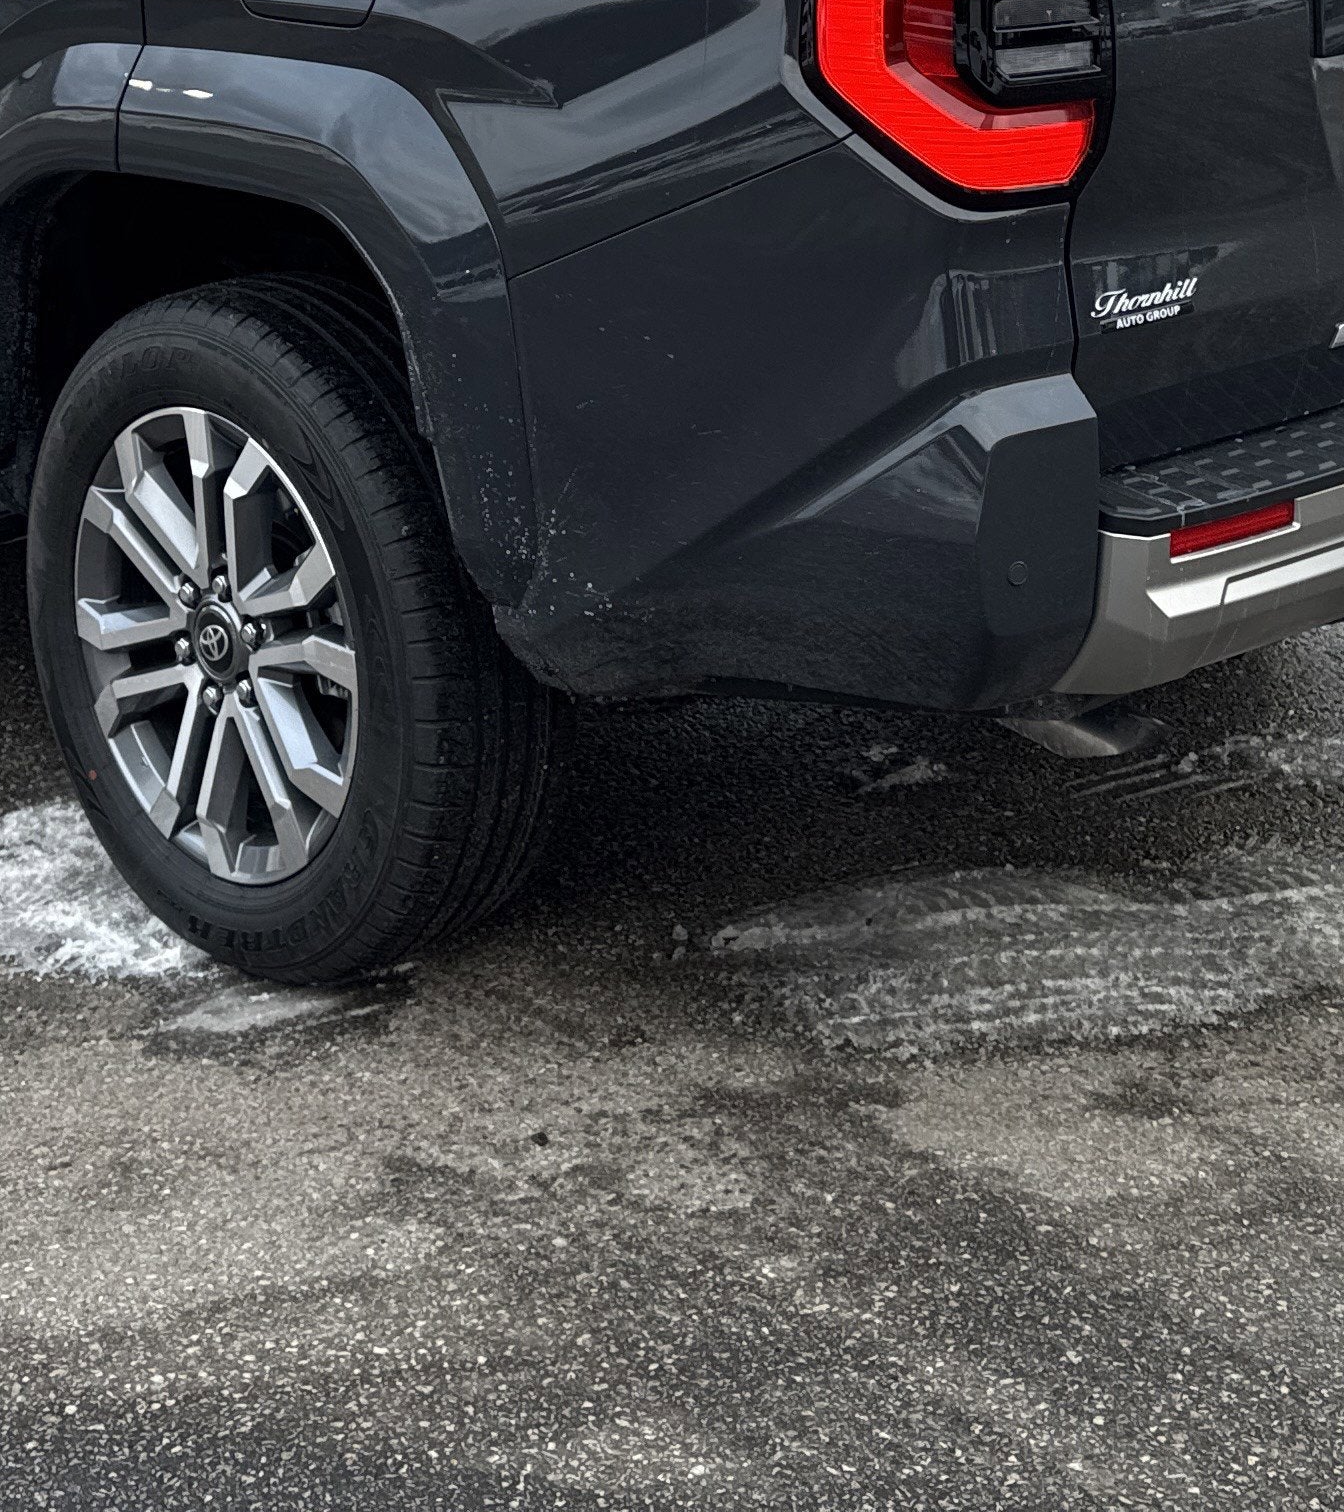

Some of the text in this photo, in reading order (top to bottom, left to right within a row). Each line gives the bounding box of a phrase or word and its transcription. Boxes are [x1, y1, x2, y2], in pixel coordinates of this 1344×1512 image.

[1090, 276, 1199, 319] Thornhill
[1115, 304, 1182, 330] AUTO GROUP
